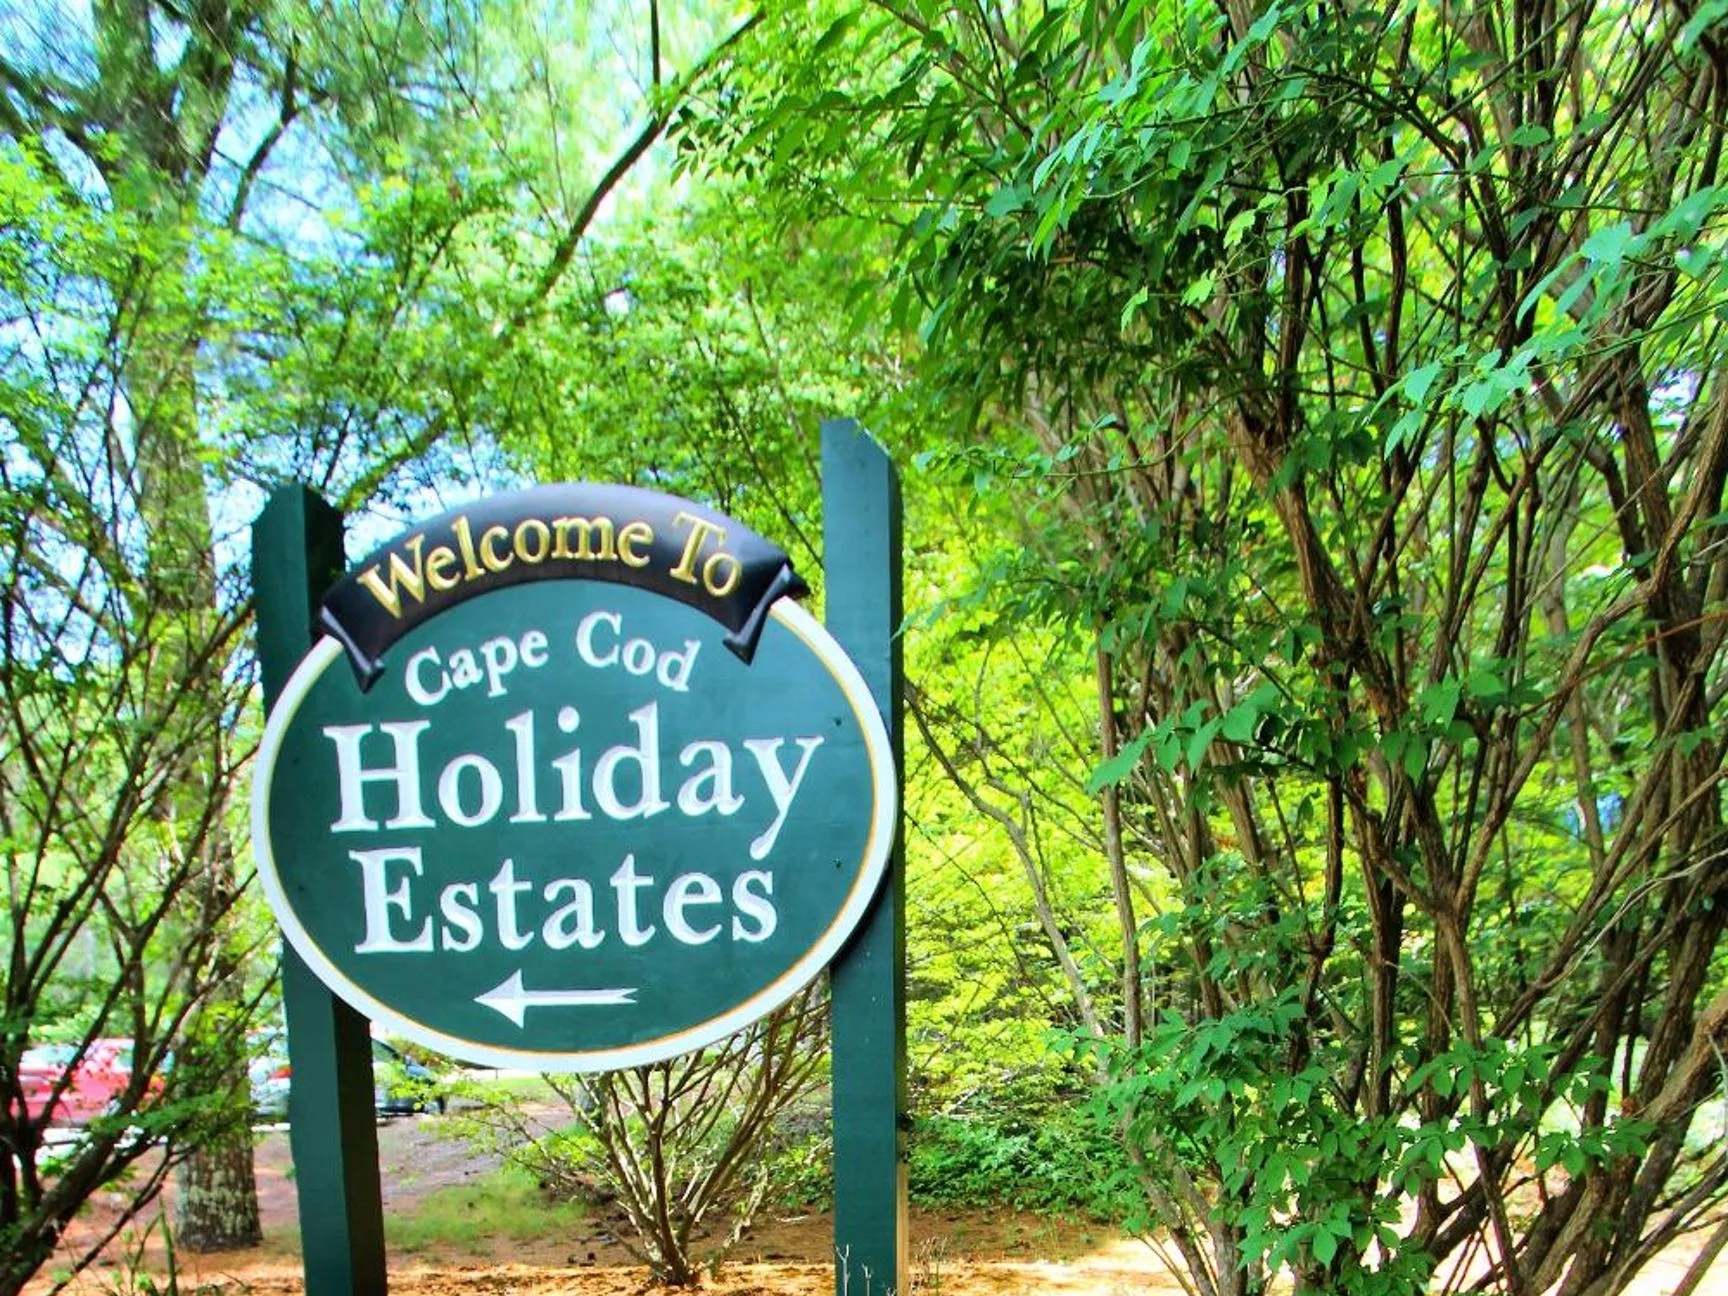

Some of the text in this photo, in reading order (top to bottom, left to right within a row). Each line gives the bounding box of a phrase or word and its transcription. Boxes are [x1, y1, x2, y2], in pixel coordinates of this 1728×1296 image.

[357, 511, 743, 620] Welcome To
[404, 610, 702, 706] Cape Cod
[322, 701, 826, 861] Holiday
[348, 846, 779, 955] Estates
